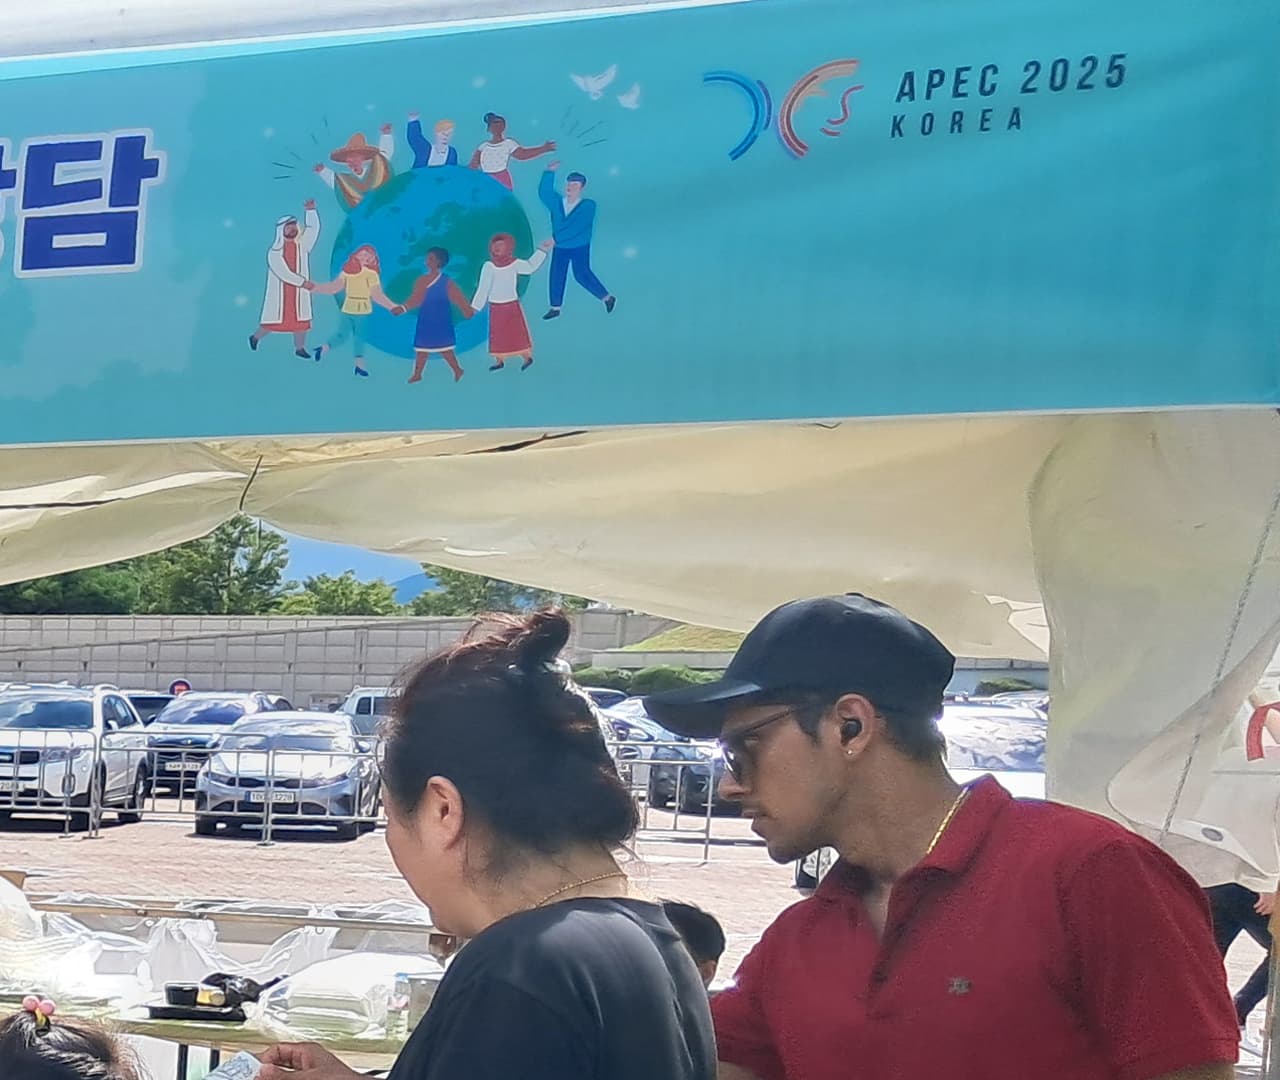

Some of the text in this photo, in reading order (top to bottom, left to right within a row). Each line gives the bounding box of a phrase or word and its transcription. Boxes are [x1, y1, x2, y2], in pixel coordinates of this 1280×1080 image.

[895, 53, 1128, 103] APEC 2025
[891, 107, 1023, 138] KOREA
